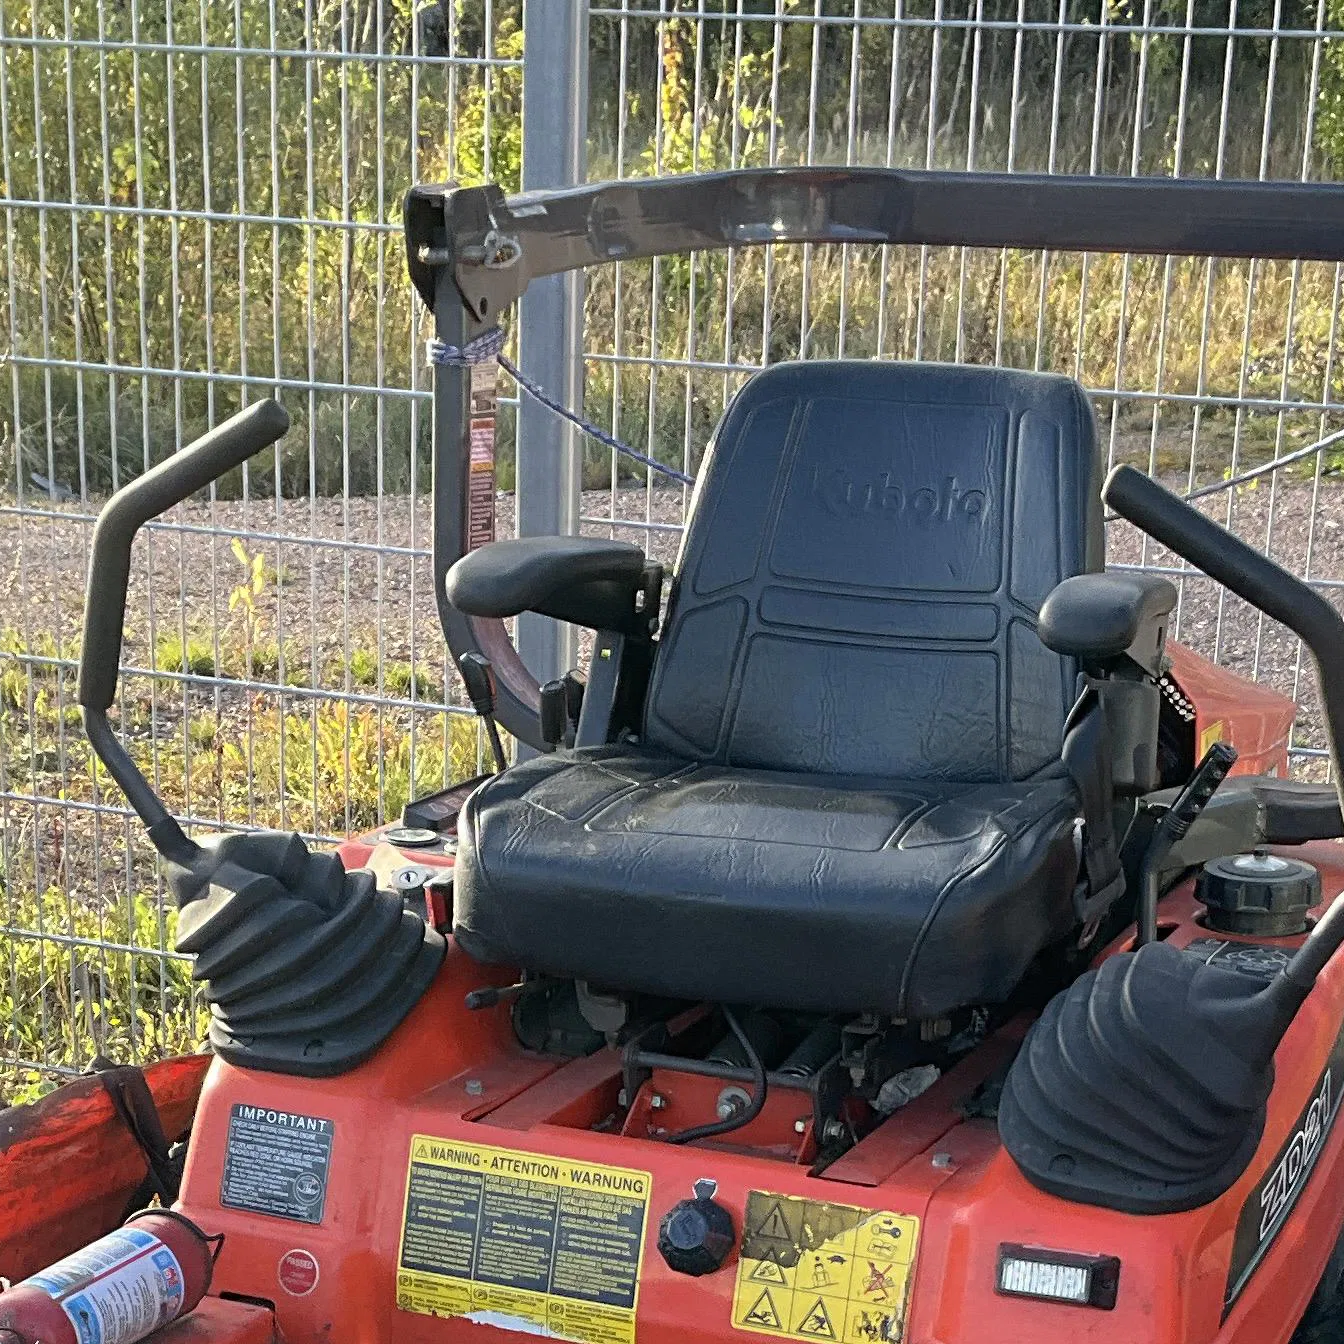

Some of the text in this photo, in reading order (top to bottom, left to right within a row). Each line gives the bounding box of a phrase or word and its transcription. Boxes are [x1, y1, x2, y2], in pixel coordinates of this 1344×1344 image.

[238, 1105, 328, 1133] IMPORTANT
[430, 1146, 645, 1194] WARNING ATTENTION WARNUNG
